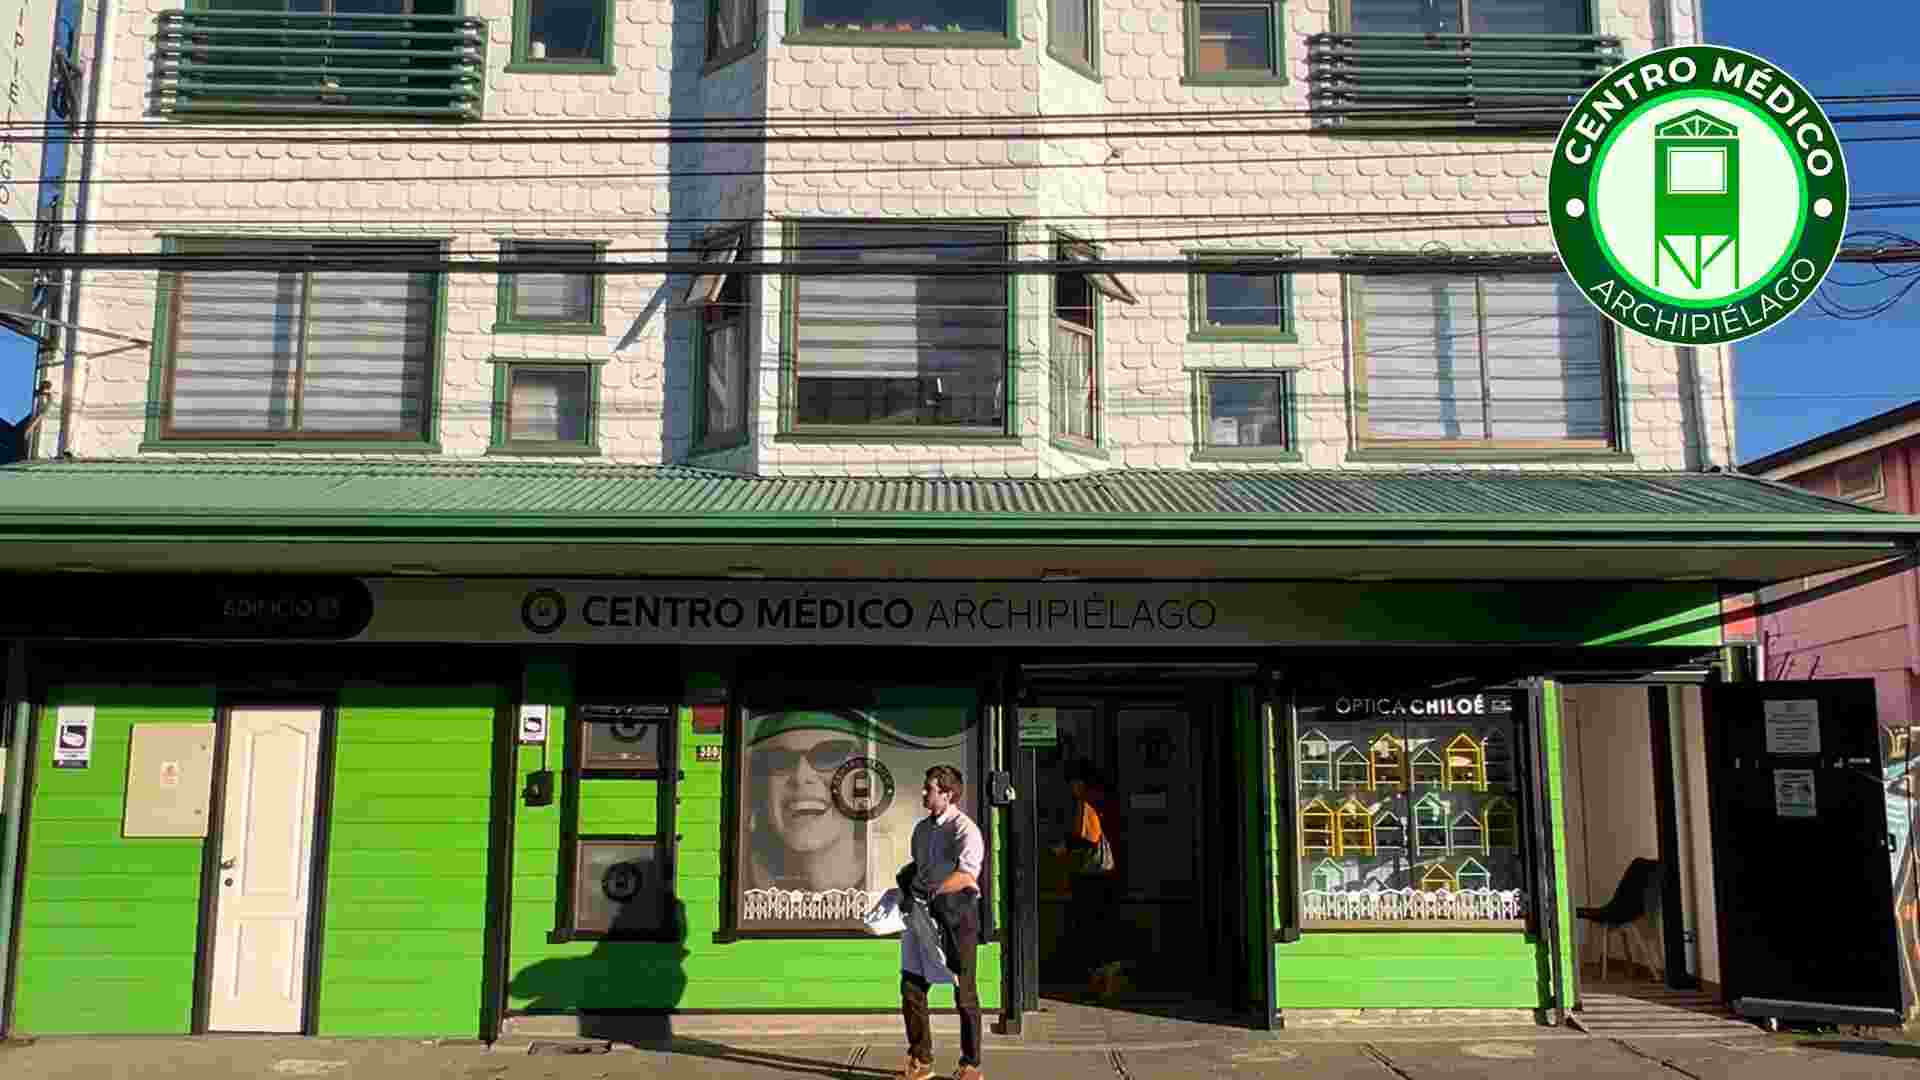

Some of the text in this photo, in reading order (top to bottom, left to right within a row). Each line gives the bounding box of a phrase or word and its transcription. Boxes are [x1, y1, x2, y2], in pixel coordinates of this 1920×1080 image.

[582, 585, 1216, 629] CENTRO MÉDICO ARCHIPIÉLAGO
[1409, 694, 1485, 714] CHILOÉ
